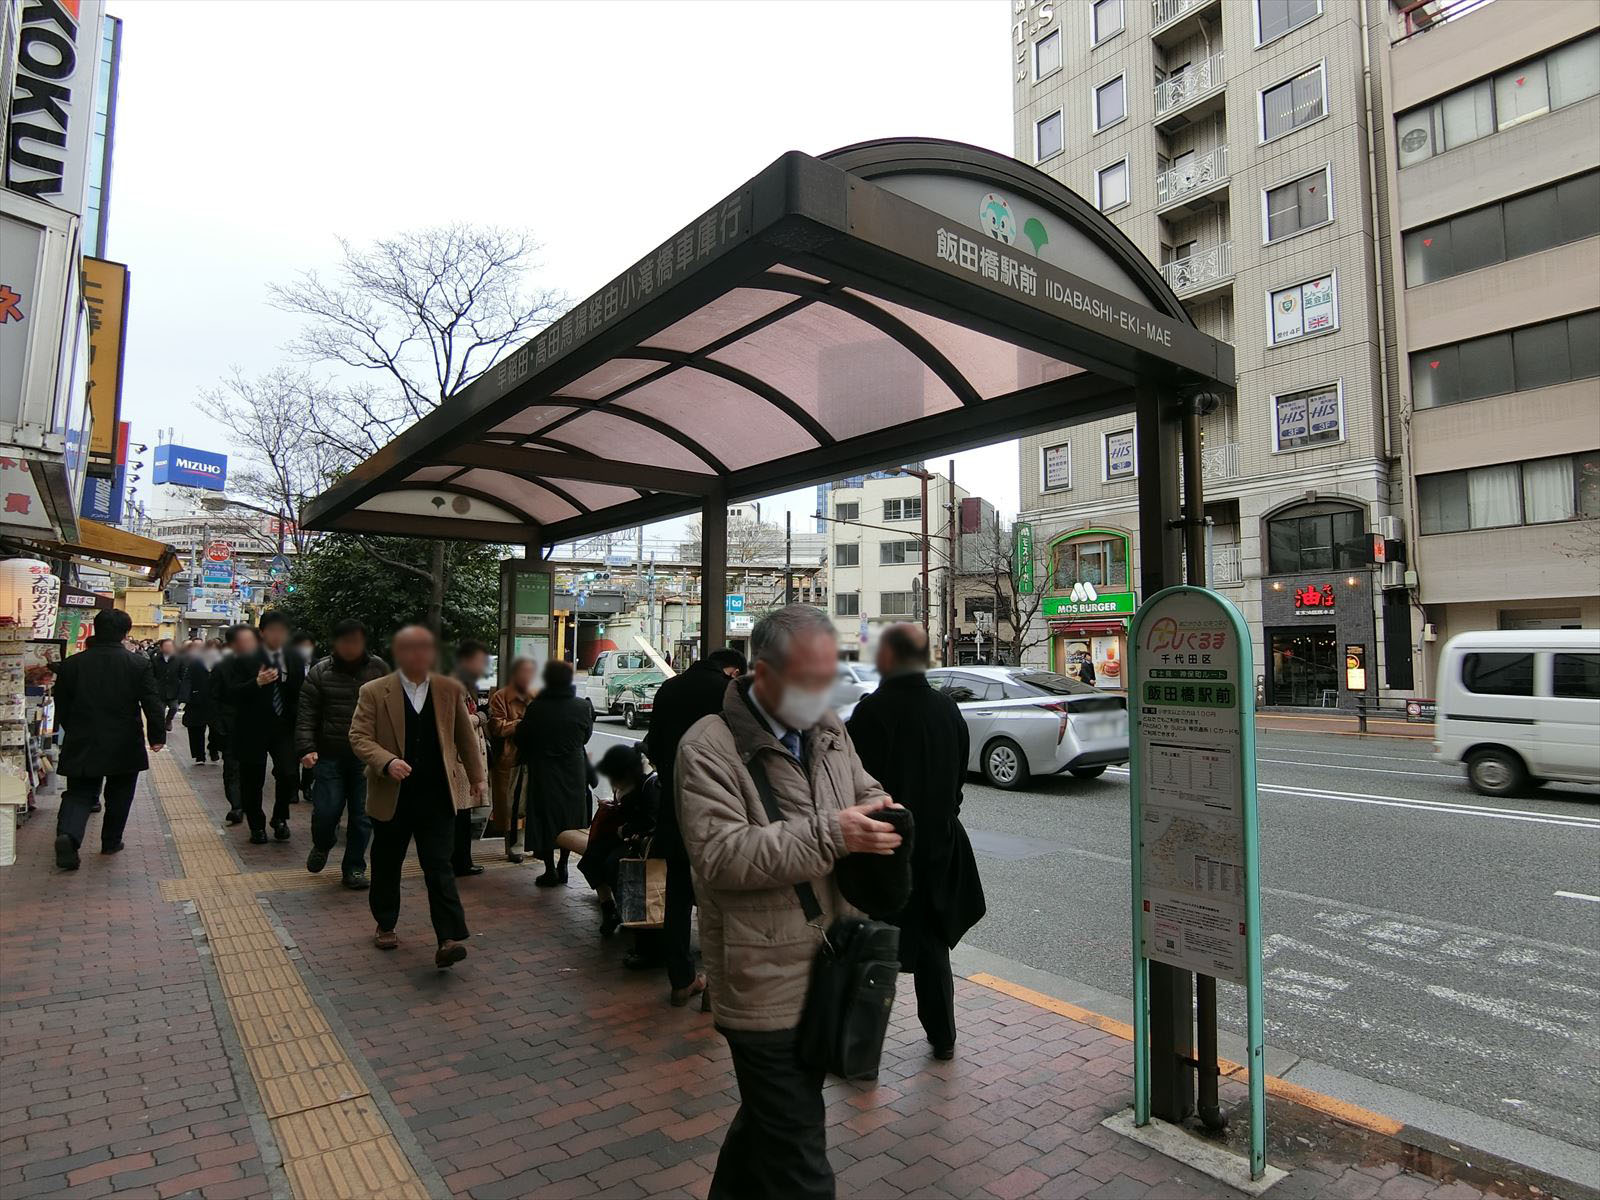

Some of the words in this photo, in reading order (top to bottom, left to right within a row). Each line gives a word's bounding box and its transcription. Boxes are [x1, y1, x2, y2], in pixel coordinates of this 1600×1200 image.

[935, 227, 1038, 297] 飯田橋駅前
[1045, 277, 1172, 348] IIDABASHI-EKI-MAE
[175, 457, 221, 475] MIZUHO
[67, 595, 94, 605] たばこ
[1058, 603, 1079, 614] MOS
[1080, 602, 1117, 613] BURGER
[1160, 653, 1212, 665] 千代田区
[1148, 685, 1231, 704] 飯田橋駅前
